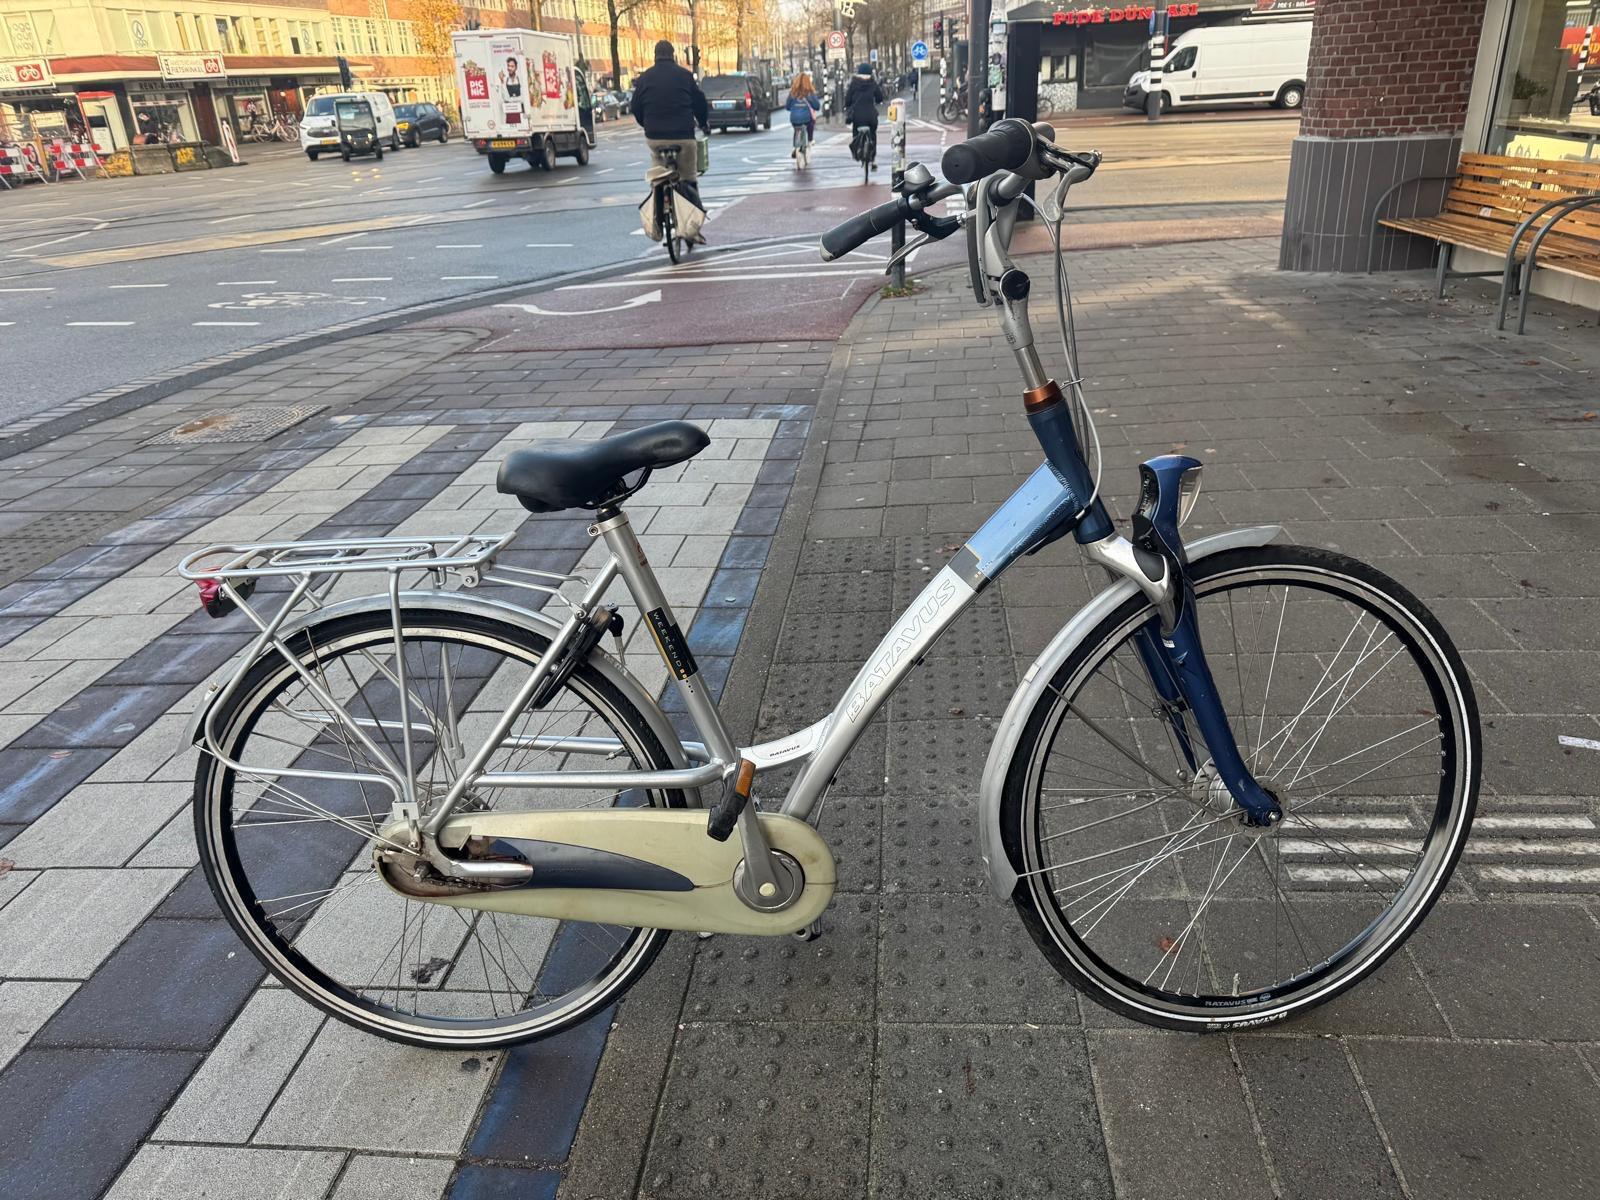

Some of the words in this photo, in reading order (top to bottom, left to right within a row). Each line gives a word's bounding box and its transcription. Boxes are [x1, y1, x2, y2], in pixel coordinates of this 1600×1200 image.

[1052, 9, 1105, 25] PIDE
[1109, 3, 1199, 22] DÜNASI
[469, 80, 484, 88] PIC
[2, 88, 60, 97] E-BIKES
[470, 88, 485, 96] NIC
[653, 611, 682, 667] WEEKEND
[846, 579, 956, 723] BATAVUS
[769, 744, 800, 757] BATAVUS
[1232, 1011, 1288, 1028] BATAVUS
